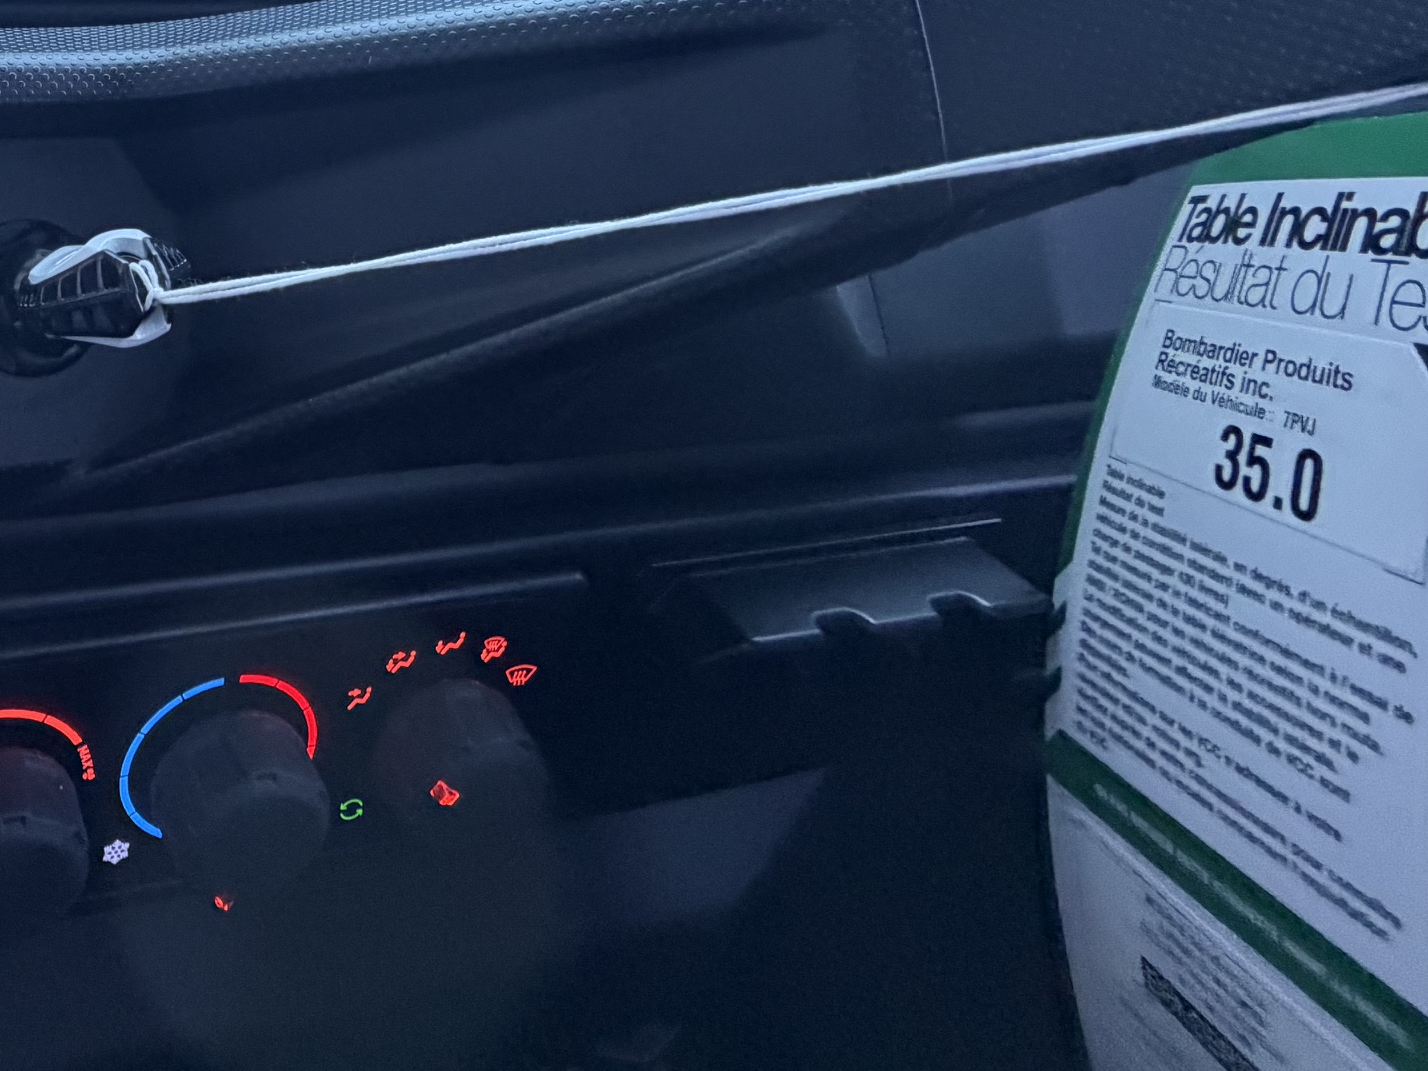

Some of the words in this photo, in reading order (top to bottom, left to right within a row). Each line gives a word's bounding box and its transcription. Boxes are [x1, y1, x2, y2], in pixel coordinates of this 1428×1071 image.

[1177, 193, 1259, 245] Table
[1154, 245, 1289, 310] Résultat
[1291, 255, 1354, 320] du
[1370, 258, 1428, 332] Te
[1155, 351, 1236, 390] Récréatifs
[1240, 371, 1274, 401] inc.
[1162, 329, 1259, 368] Bombardier
[1261, 349, 1354, 391] Produits
[1192, 386, 1208, 403] du
[1283, 410, 1317, 437] TPVJ
[1214, 424, 1323, 522] 35.0
[77, 744, 94, 770] MAX
